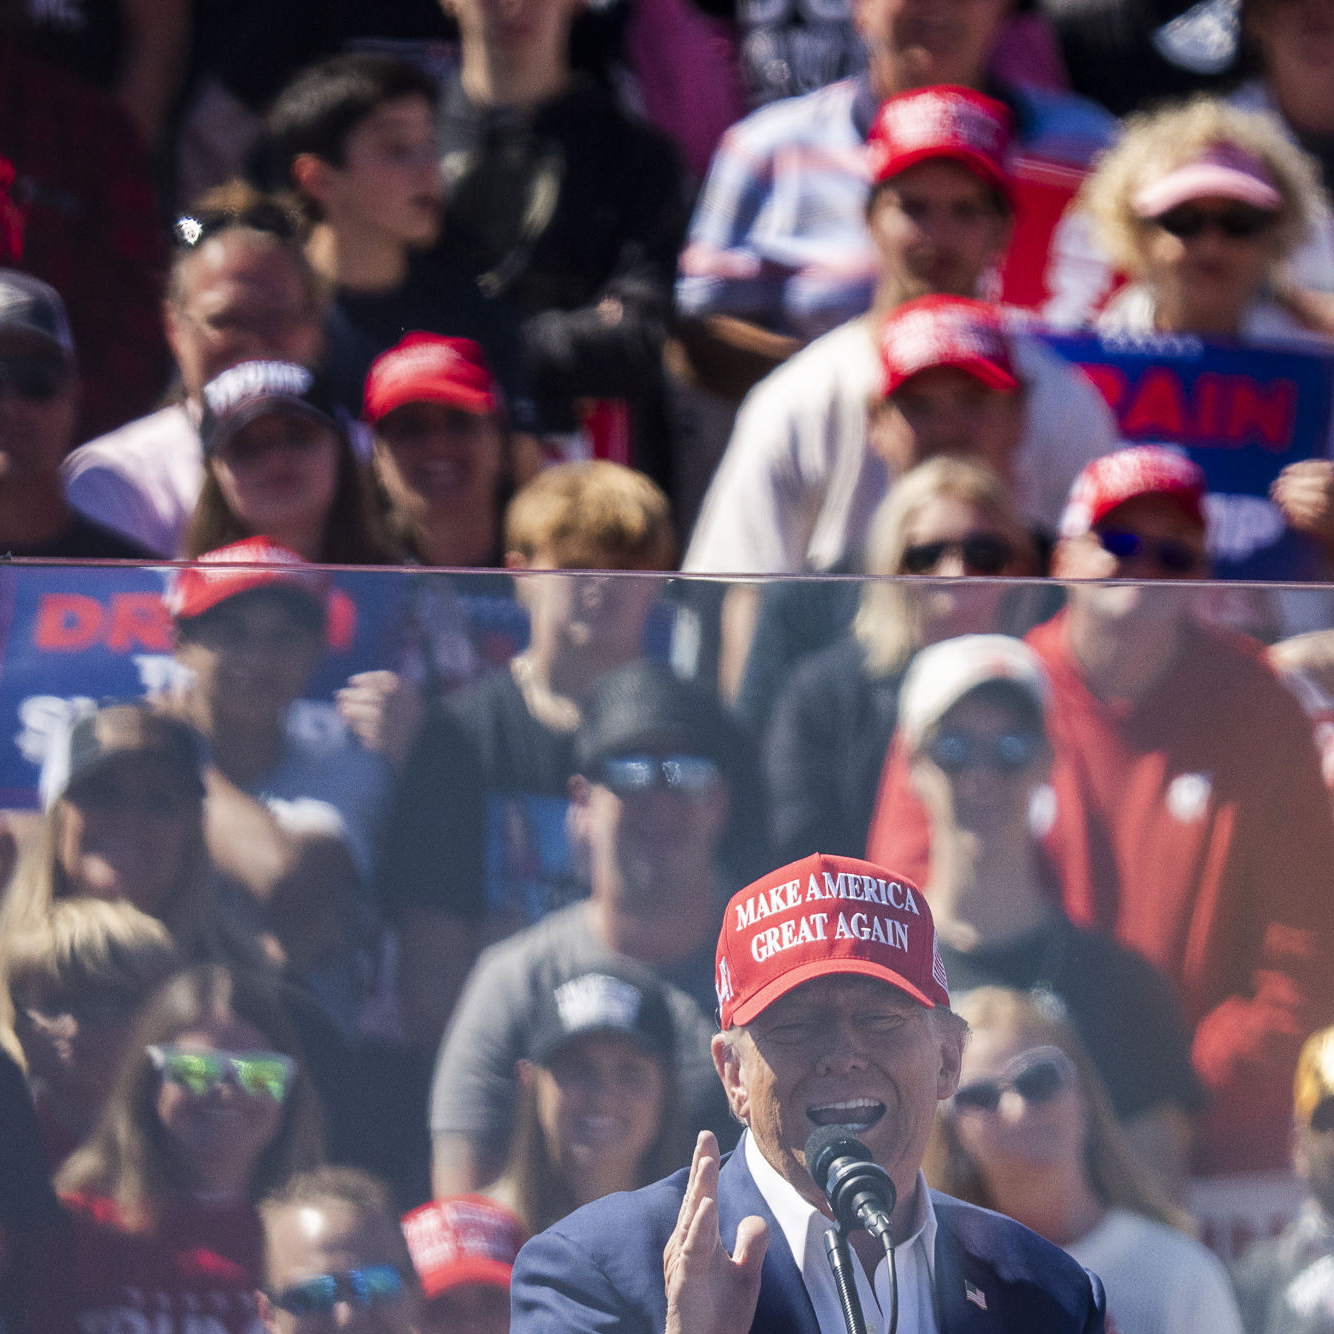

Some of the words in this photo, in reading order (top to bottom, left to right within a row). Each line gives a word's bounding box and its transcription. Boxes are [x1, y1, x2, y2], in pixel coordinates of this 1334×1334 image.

[734, 879, 802, 931] MAKE
[805, 871, 920, 915] AMERICA
[751, 912, 828, 963] GREAT
[834, 911, 909, 953] AGAIN
